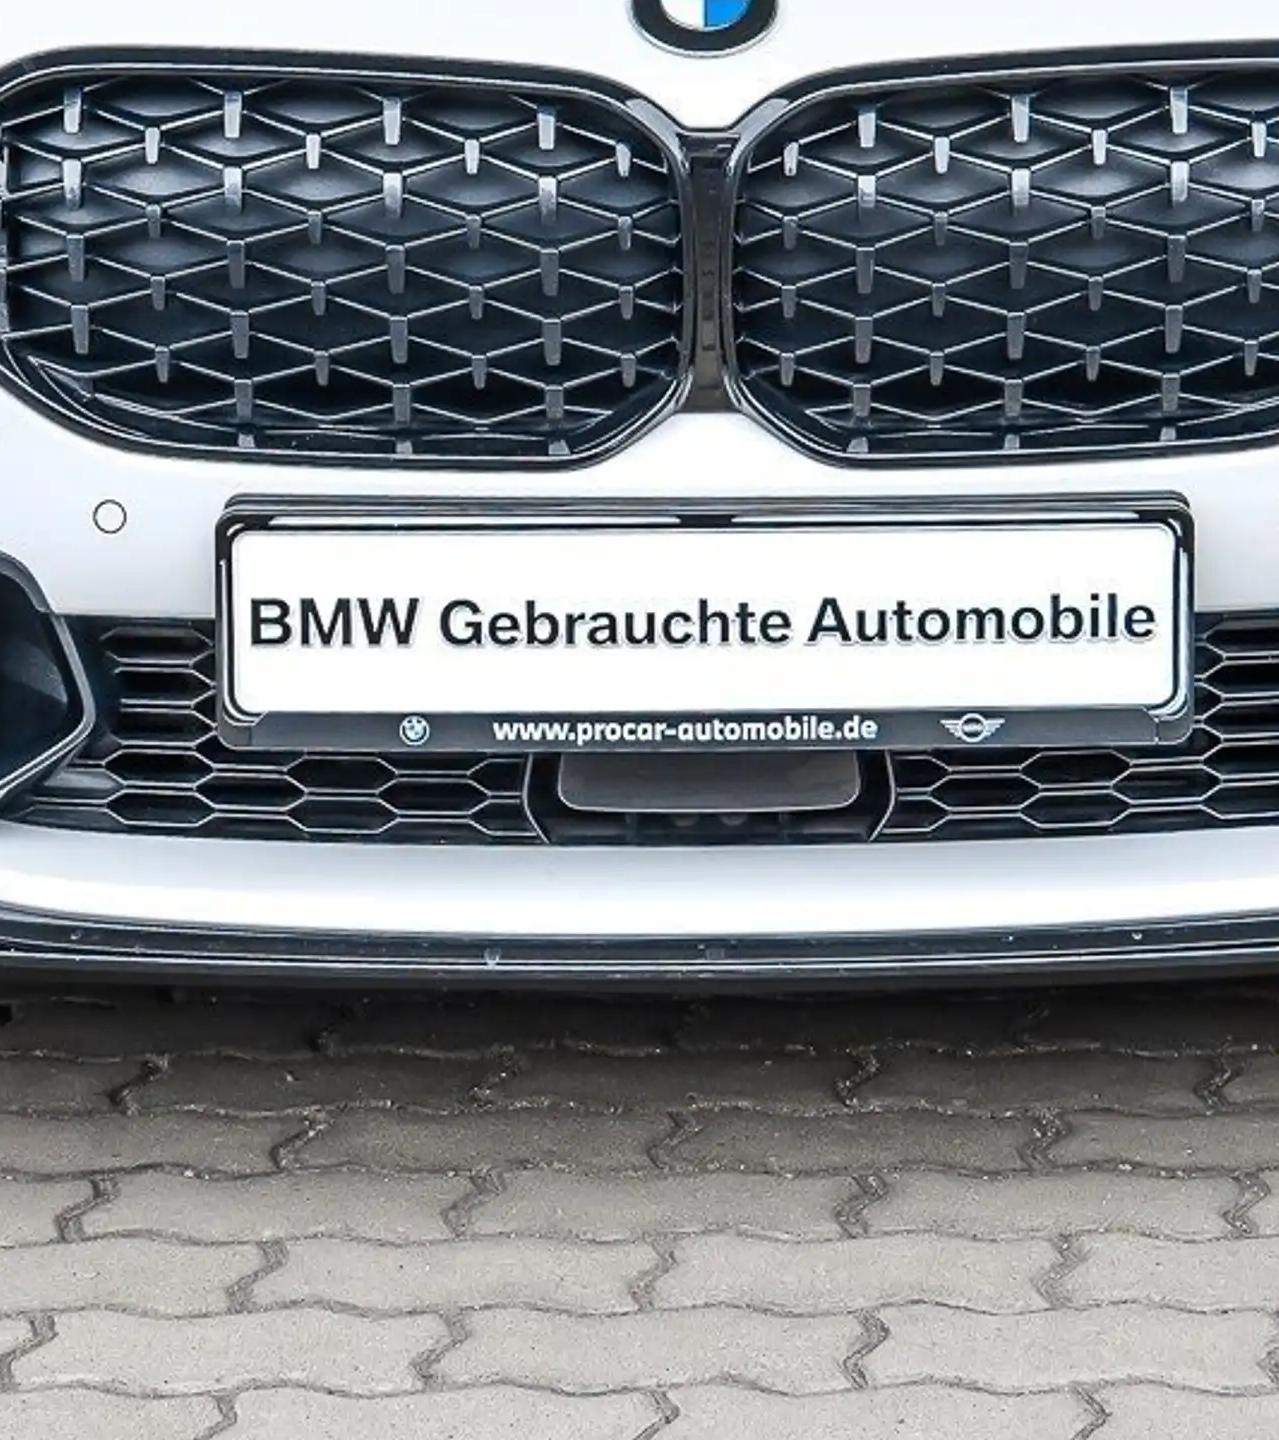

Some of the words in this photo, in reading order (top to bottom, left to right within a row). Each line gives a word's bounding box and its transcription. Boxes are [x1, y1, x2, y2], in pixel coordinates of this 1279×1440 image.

[249, 597, 421, 647] BMW
[439, 598, 793, 647] Gebrauchte
[806, 591, 1157, 643] Automobile
[491, 714, 879, 748] www.procar-automobile.de
